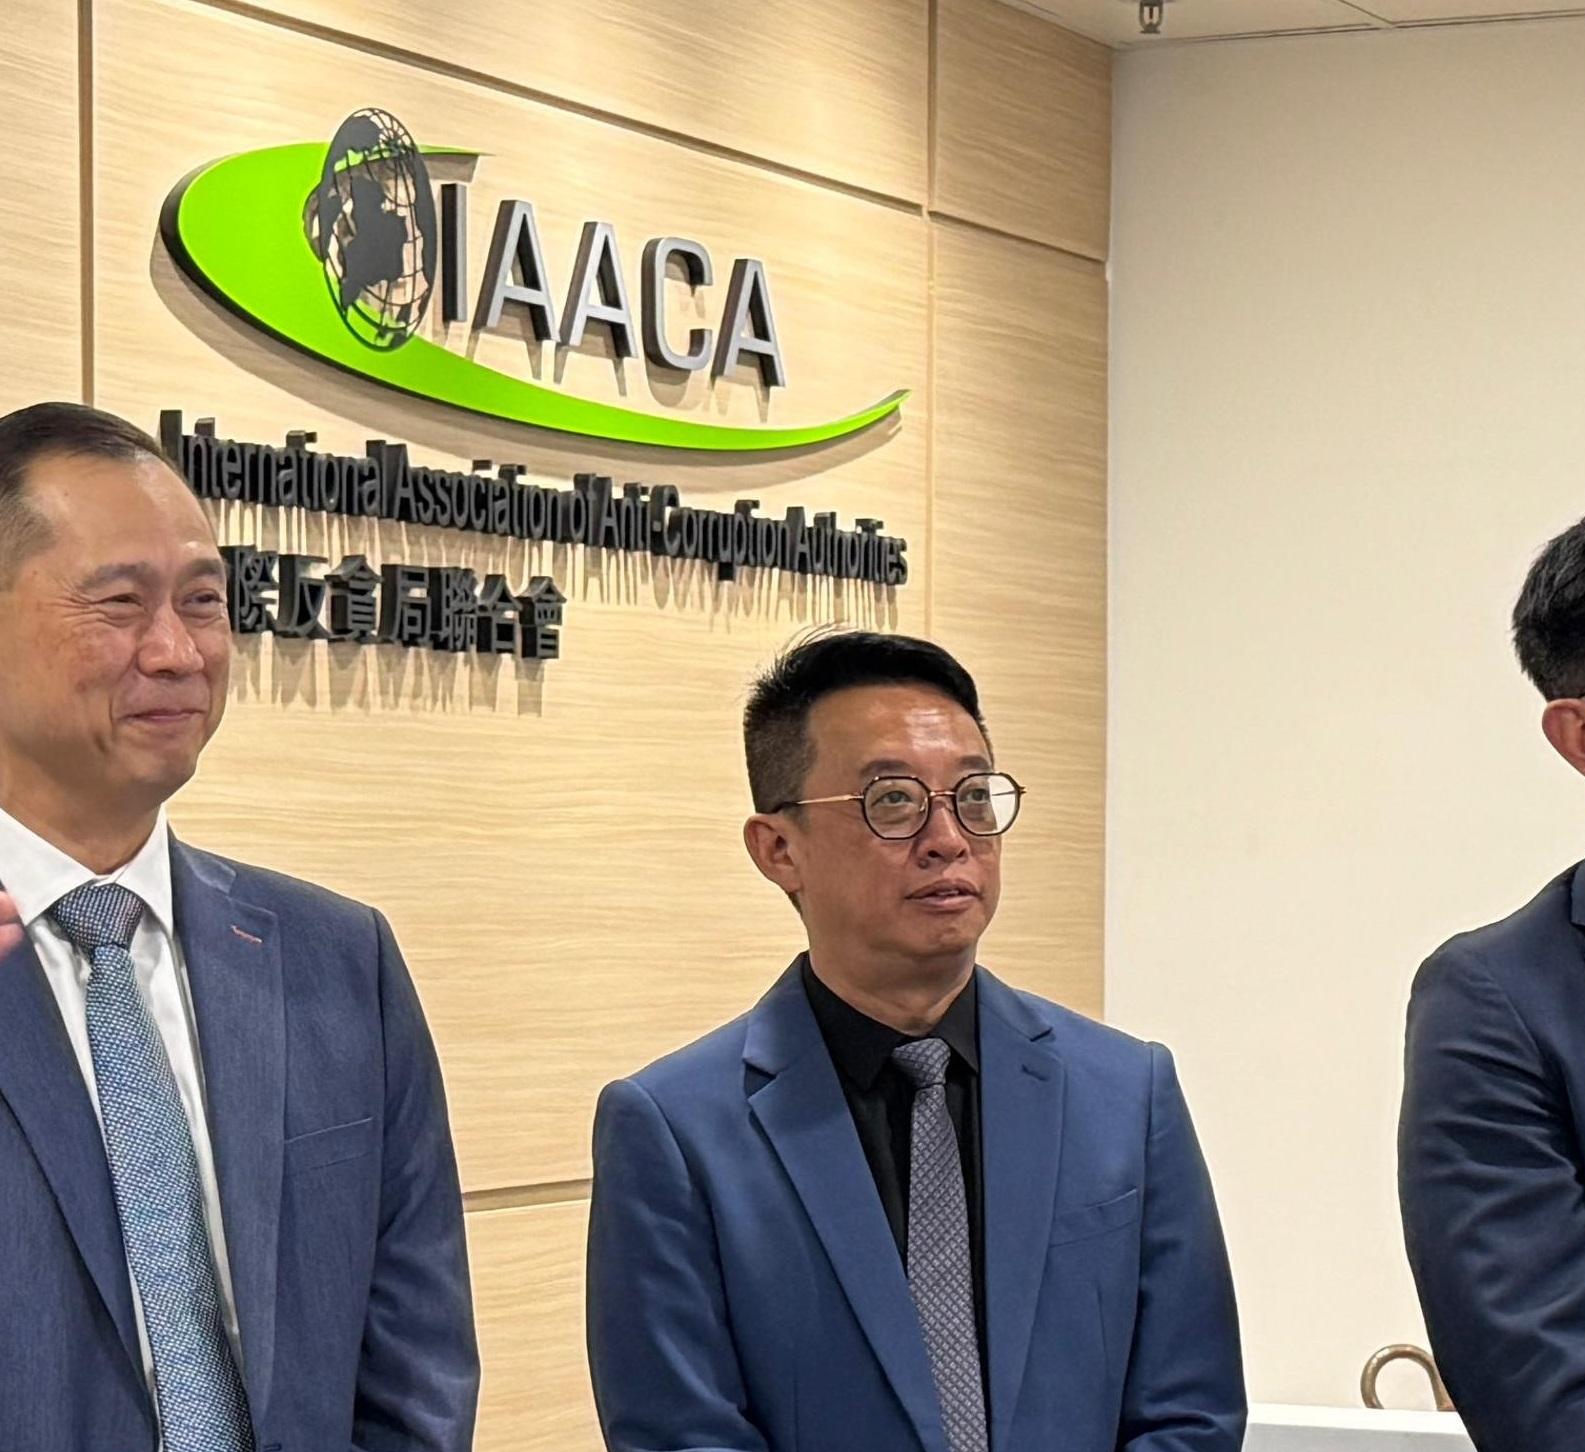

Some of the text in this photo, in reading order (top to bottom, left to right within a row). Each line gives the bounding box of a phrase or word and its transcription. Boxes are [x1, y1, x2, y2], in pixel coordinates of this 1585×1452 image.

[441, 183, 785, 388] IAACA
[160, 410, 908, 585] International Association of Anti-Corruption Authorities
